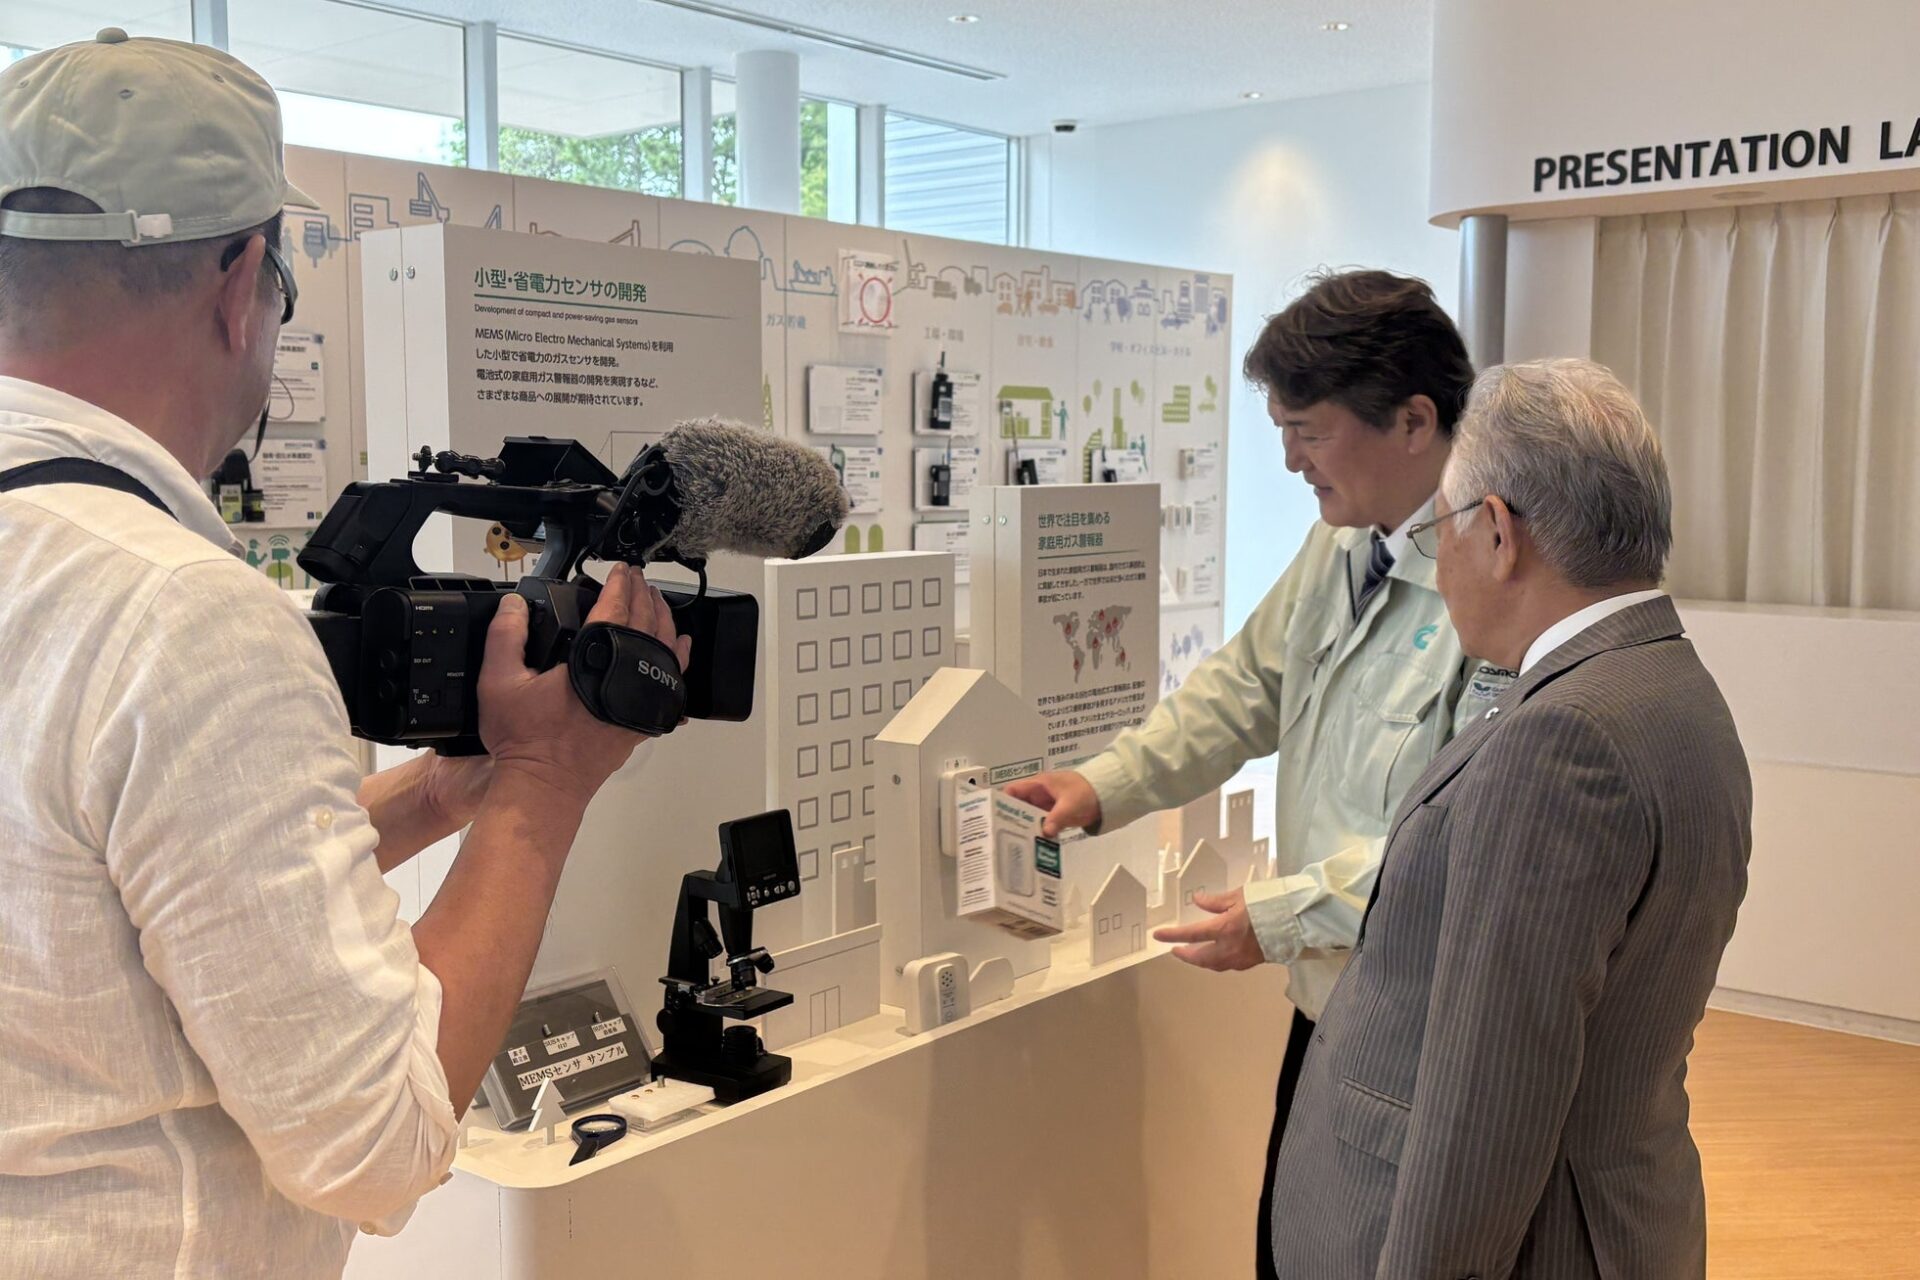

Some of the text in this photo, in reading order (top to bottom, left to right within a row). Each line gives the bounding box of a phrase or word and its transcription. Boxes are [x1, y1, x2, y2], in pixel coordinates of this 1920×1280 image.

[1533, 125, 1851, 193] PRESENTATION
[474, 267, 647, 303] 小型・省電力センサの開発
[474, 304, 517, 315] Development
[525, 309, 552, 319] compact
[565, 313, 604, 324] power-saving
[605, 317, 616, 325] gas
[616, 318, 638, 326] sensors
[535, 332, 565, 344] Electro
[567, 334, 615, 348] Mechanical
[476, 348, 620, 367] した小型で省電力のガスセンサを開発。
[1038, 512, 1110, 528] 世界で注目を集める
[1038, 532, 1103, 550] 家庭用ガス警報器
[638, 660, 678, 690] SONY
[586, 1045, 625, 1066] サンプル
